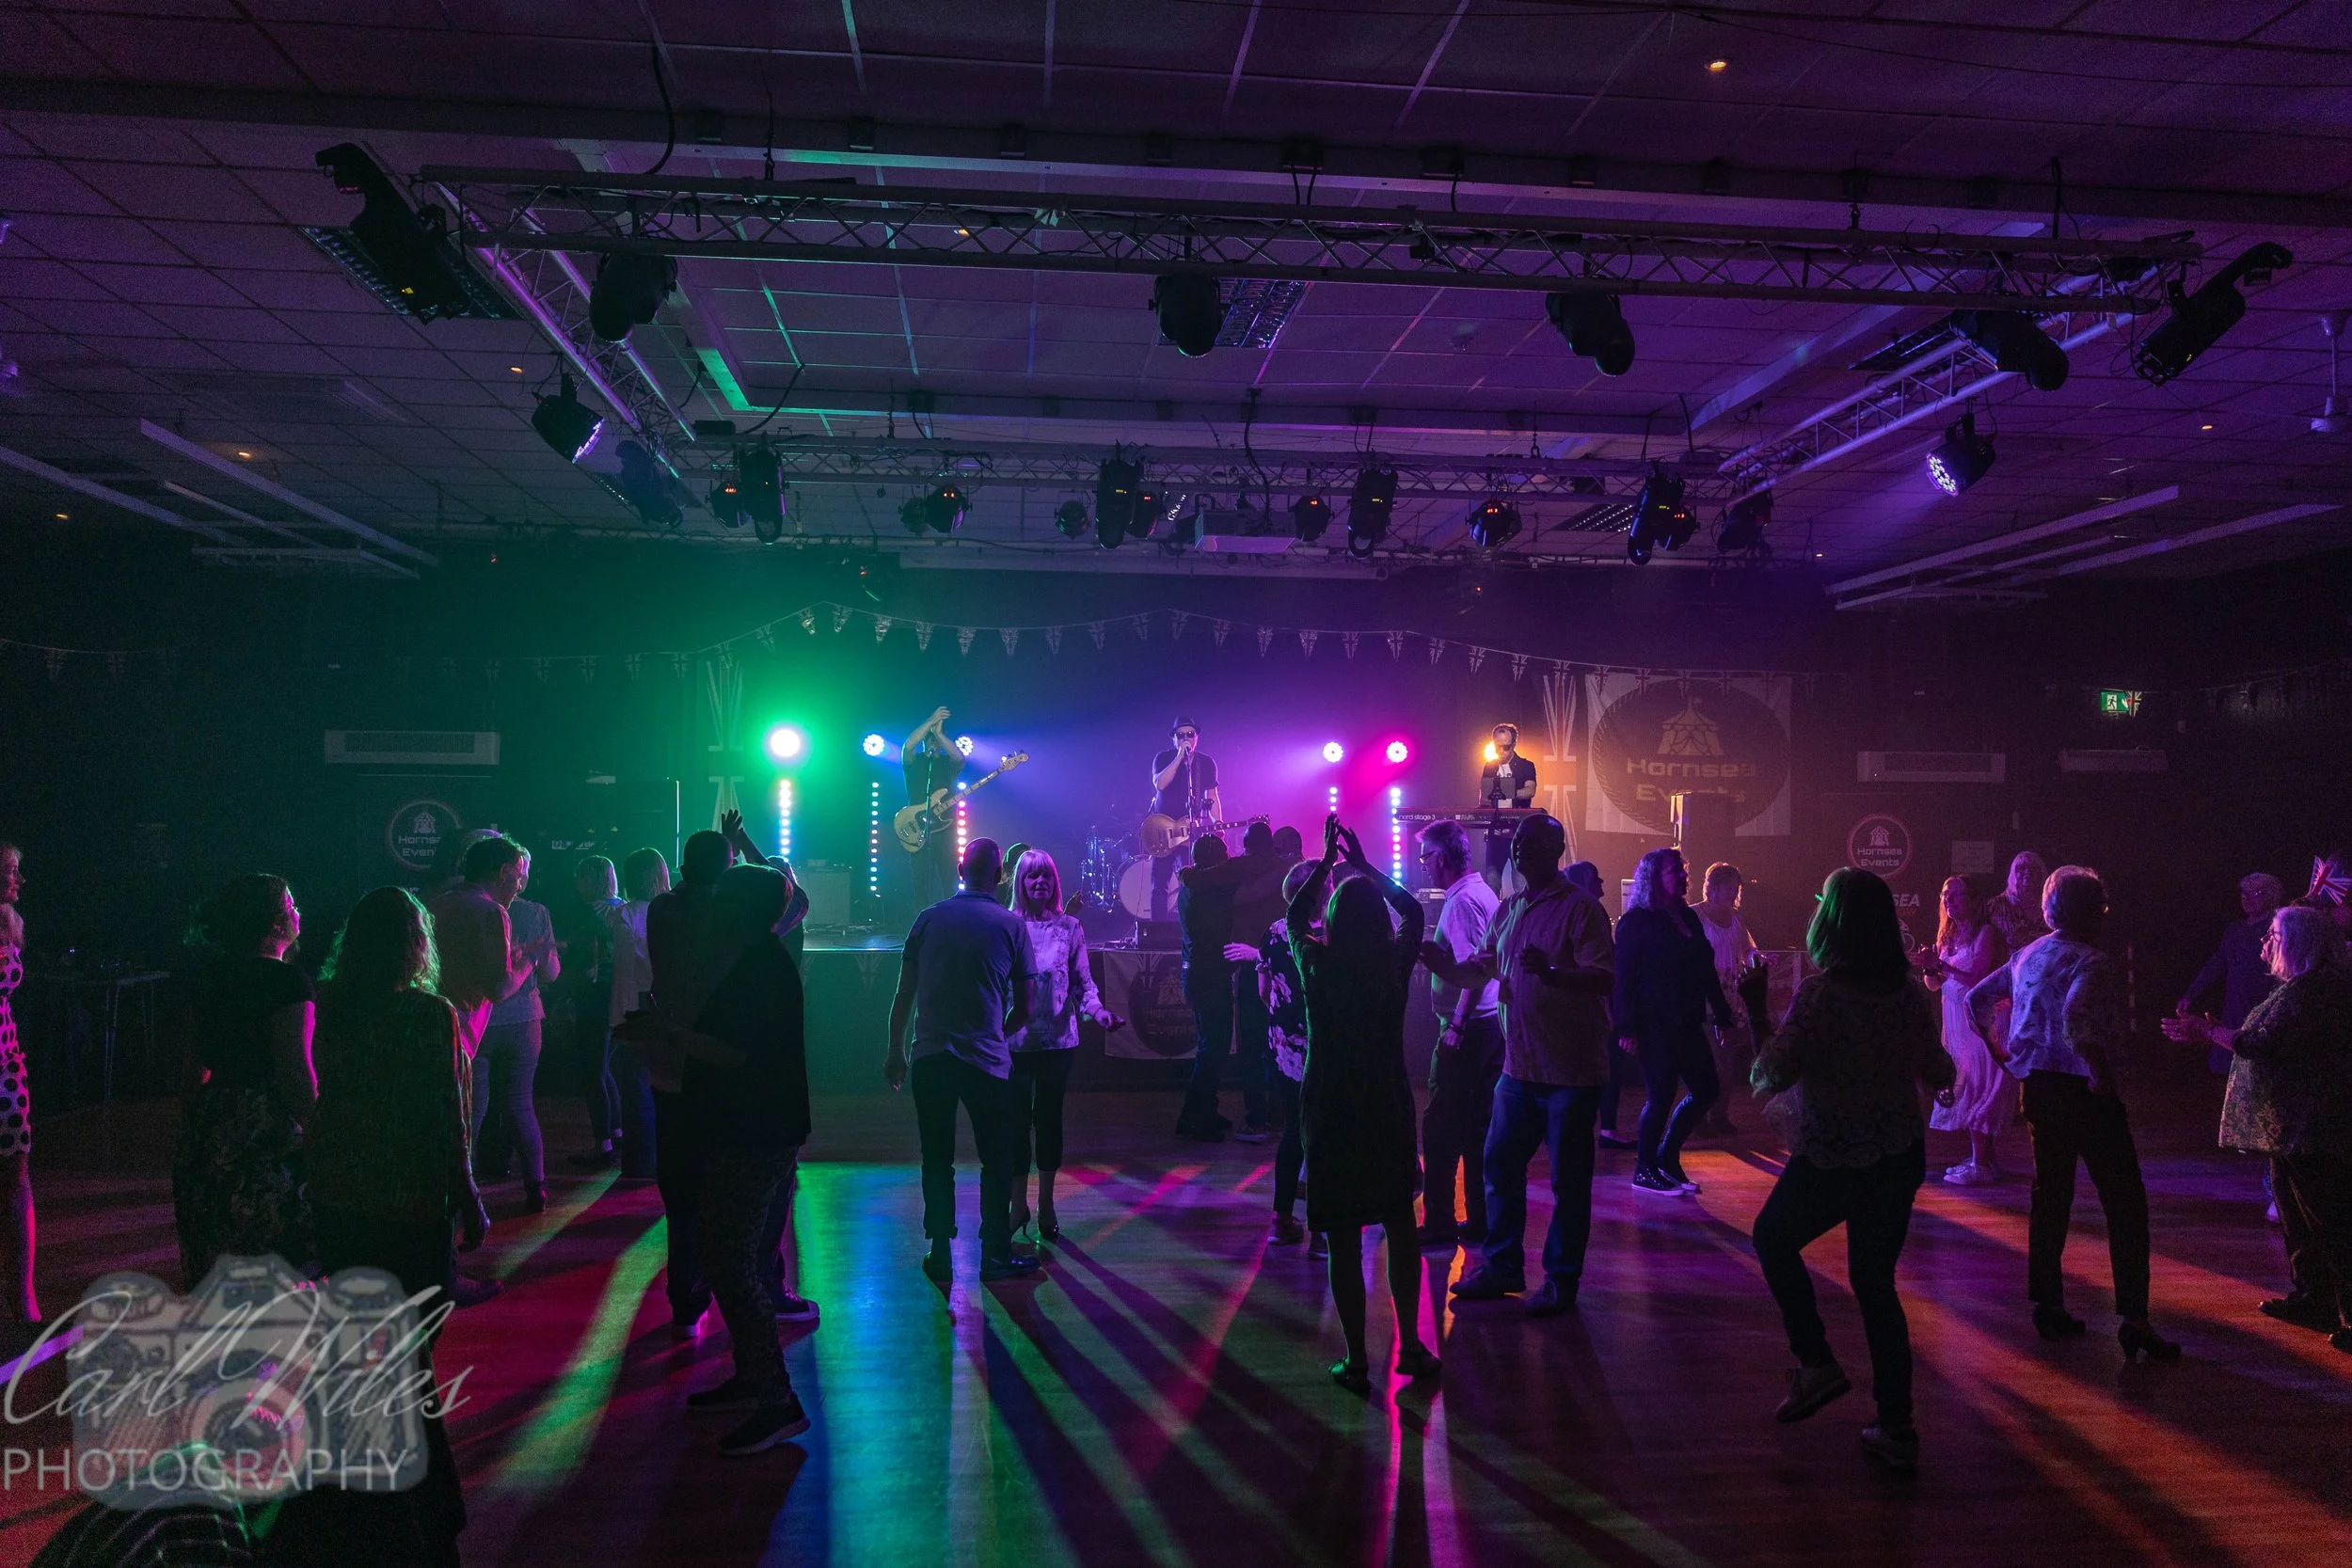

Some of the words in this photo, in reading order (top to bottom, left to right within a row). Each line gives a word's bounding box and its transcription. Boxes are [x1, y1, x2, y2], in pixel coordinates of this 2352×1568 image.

[1626, 757, 1756, 778] Hornsea
[1414, 814, 1431, 822] stage
[403, 847, 437, 857] Even
[1857, 847, 1902, 856] Hornsea
[1860, 858, 1899, 866] Events
